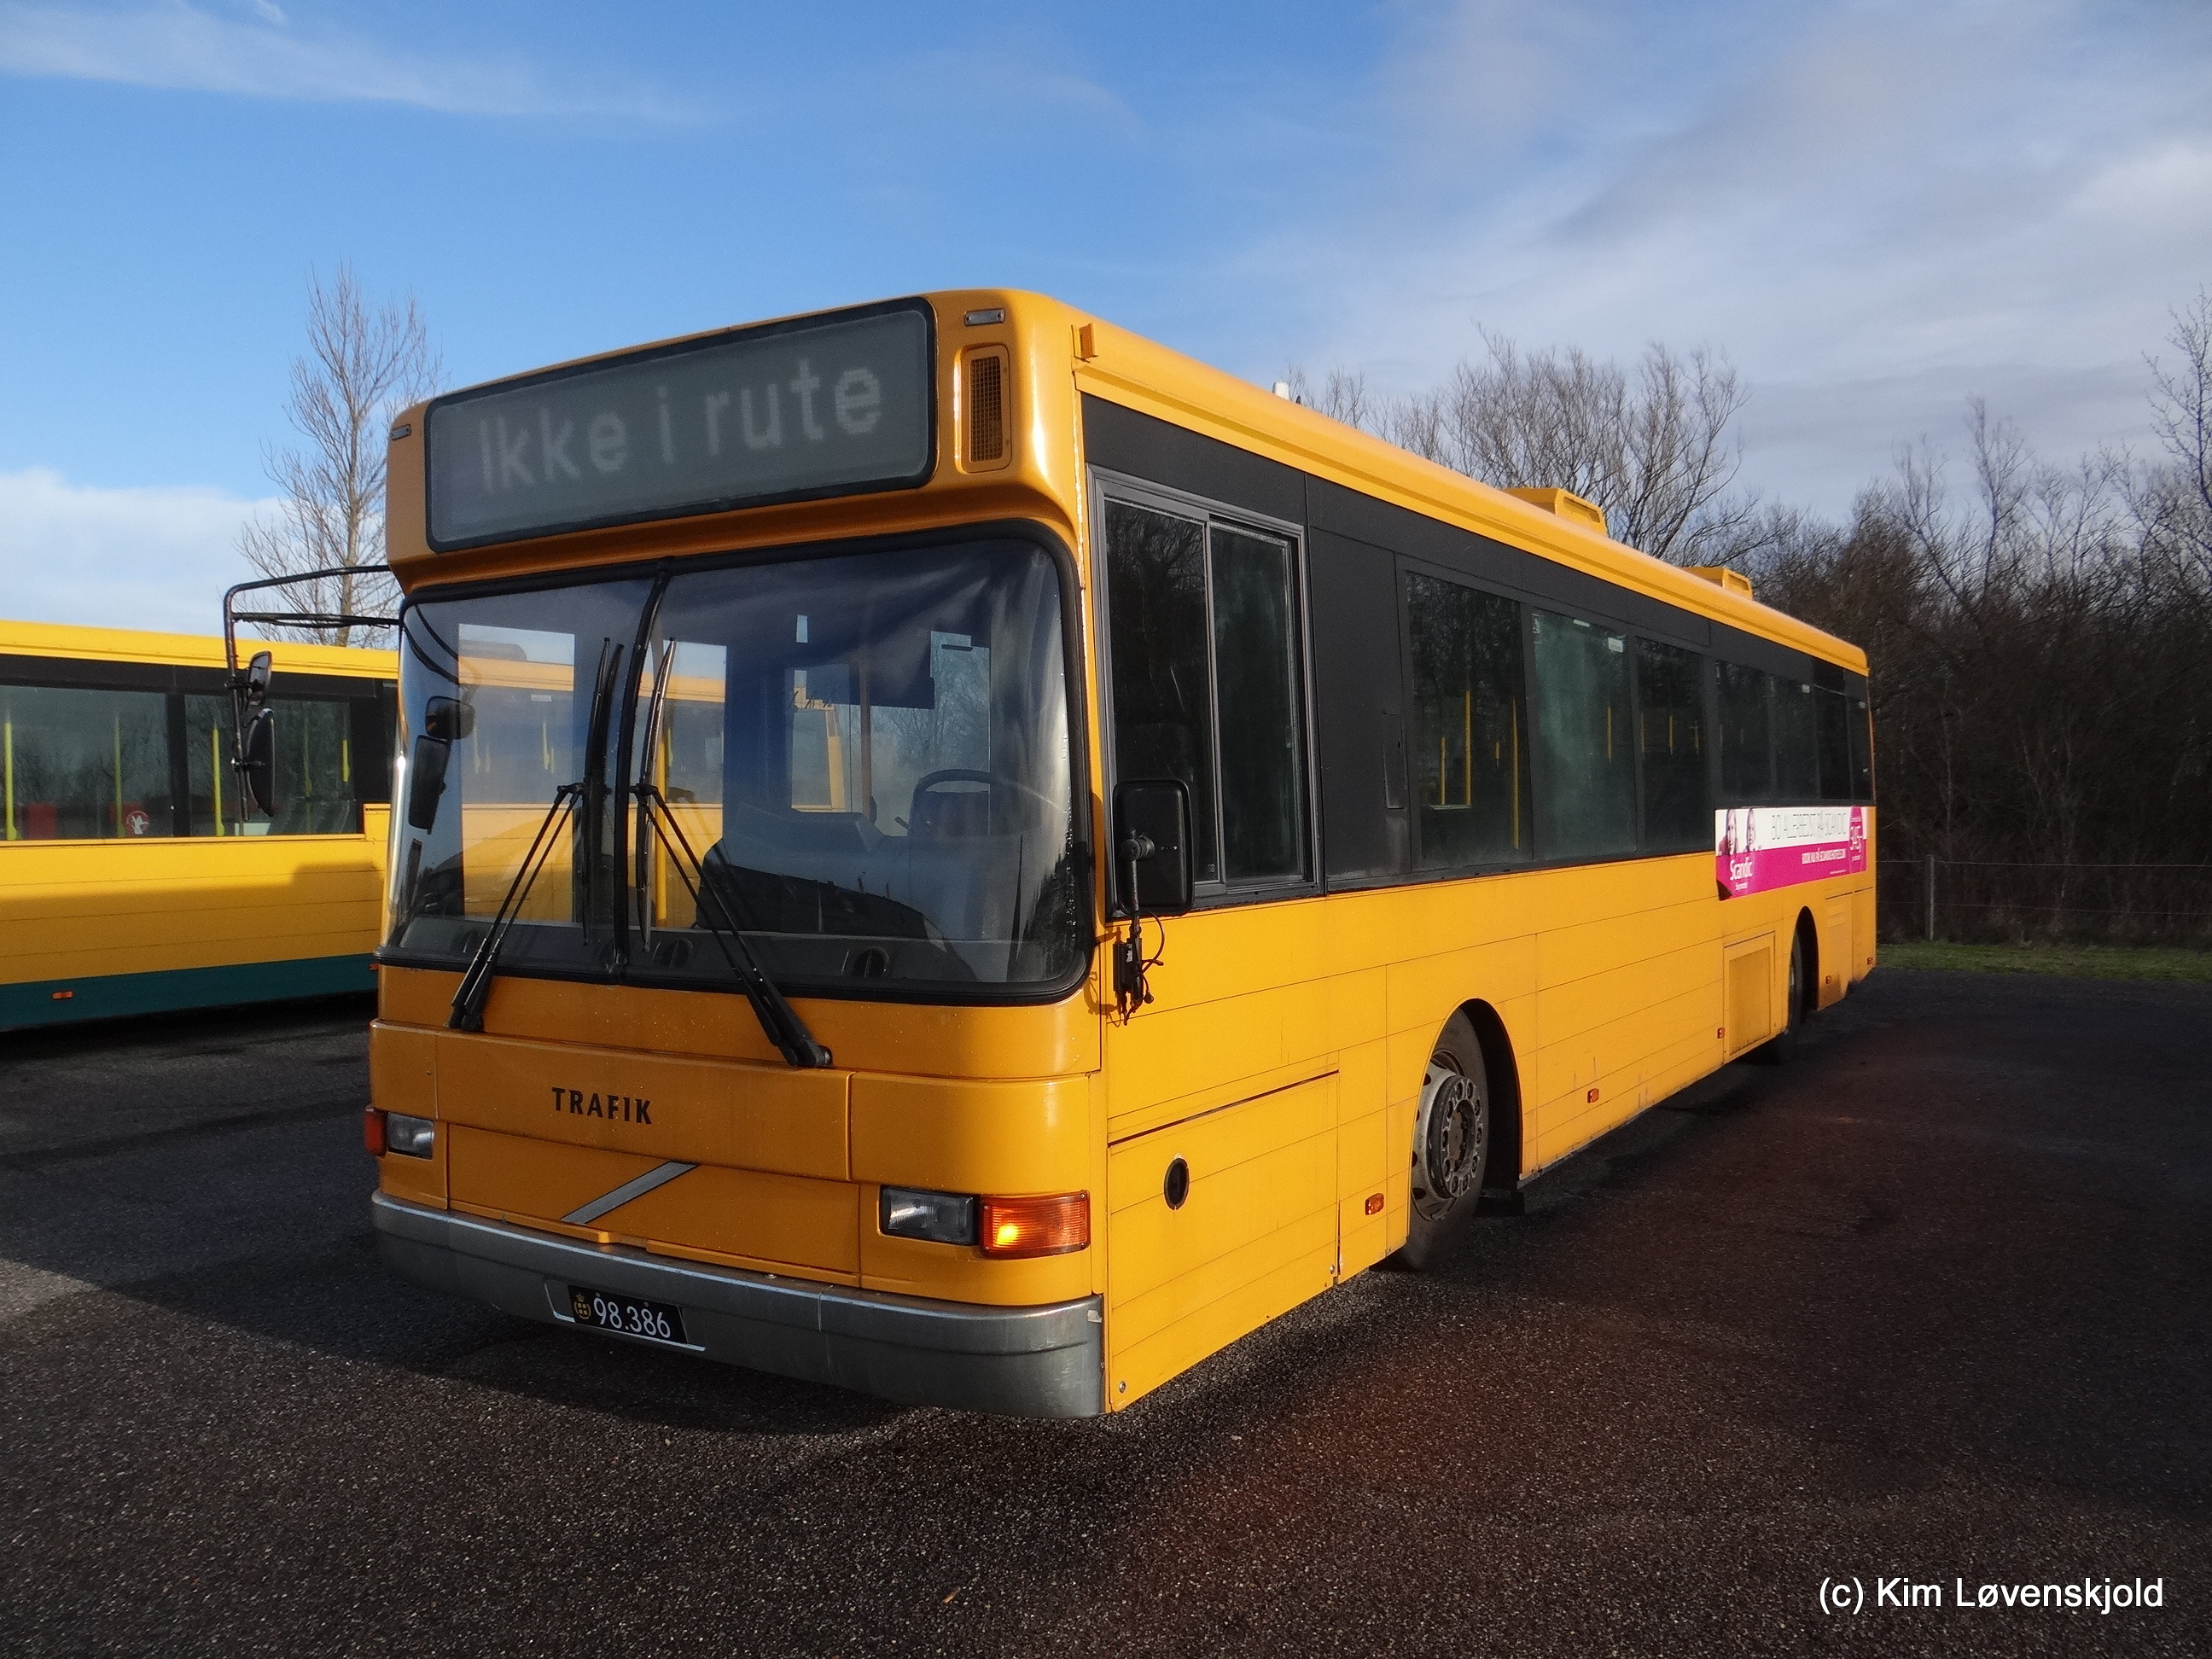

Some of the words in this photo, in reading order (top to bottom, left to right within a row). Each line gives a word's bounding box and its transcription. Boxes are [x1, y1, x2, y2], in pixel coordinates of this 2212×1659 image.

[479, 408, 627, 494] Ikke
[656, 385, 675, 464] i
[704, 358, 882, 457] rute
[1730, 856, 1753, 881] Scandic
[551, 1086, 652, 1125] TRAFIK
[593, 1296, 671, 1339] 98.386
